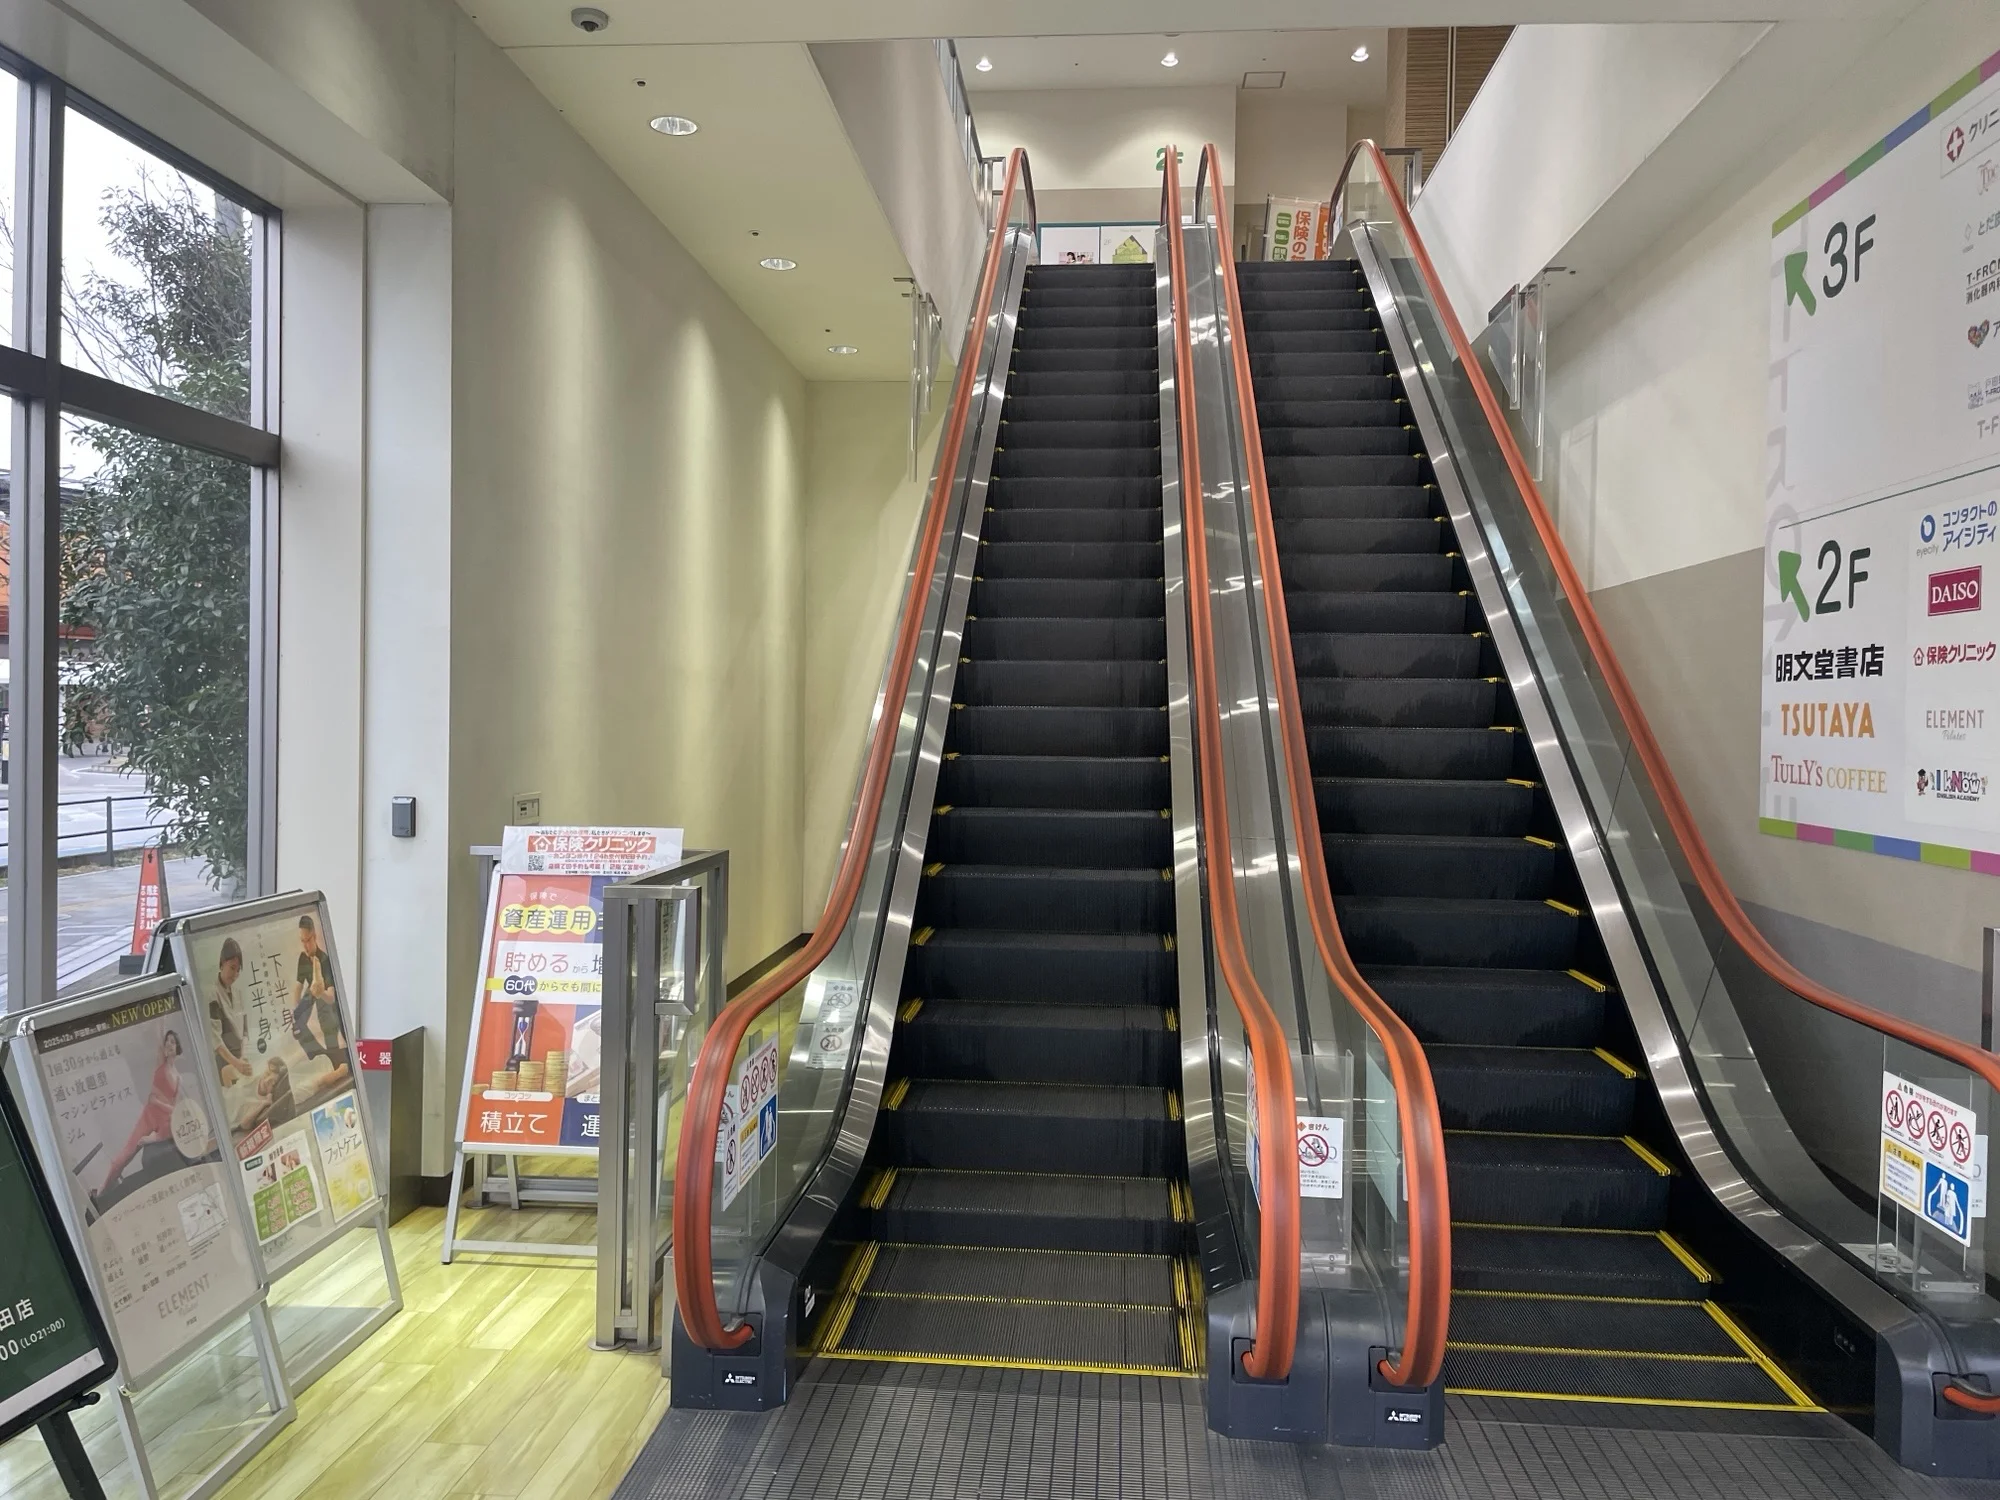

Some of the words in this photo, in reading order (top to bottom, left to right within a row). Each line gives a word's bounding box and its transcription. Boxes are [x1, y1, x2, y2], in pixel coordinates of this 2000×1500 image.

[1822, 213, 1877, 298] 3F
[1966, 258, 2000, 285] T-FRO
[1942, 500, 1998, 528] コンタクトの
[1942, 522, 1998, 552] アイシティ
[1815, 539, 1871, 614] 2F
[1931, 579, 1979, 604] DAISO
[1775, 643, 1885, 683] 明文堂書店
[1926, 641, 1997, 666] 保険クリニック
[1781, 702, 1875, 739] TSUTAYA
[1926, 709, 1984, 729] ELEMENT
[1826, 767, 1887, 794] COFFEE
[552, 835, 653, 853] 保険クリニック
[503, 906, 603, 932] 資産運用
[248, 960, 272, 1041] 上半身
[267, 952, 296, 1033] 下半身
[111, 1004, 140, 1028] NEW
[142, 996, 177, 1018] OPEN!
[480, 1110, 549, 1134] 積立て
[1308, 1123, 1330, 1131] きけん
[66, 1127, 86, 1145] ジム
[158, 1272, 210, 1320] ELEMENT
